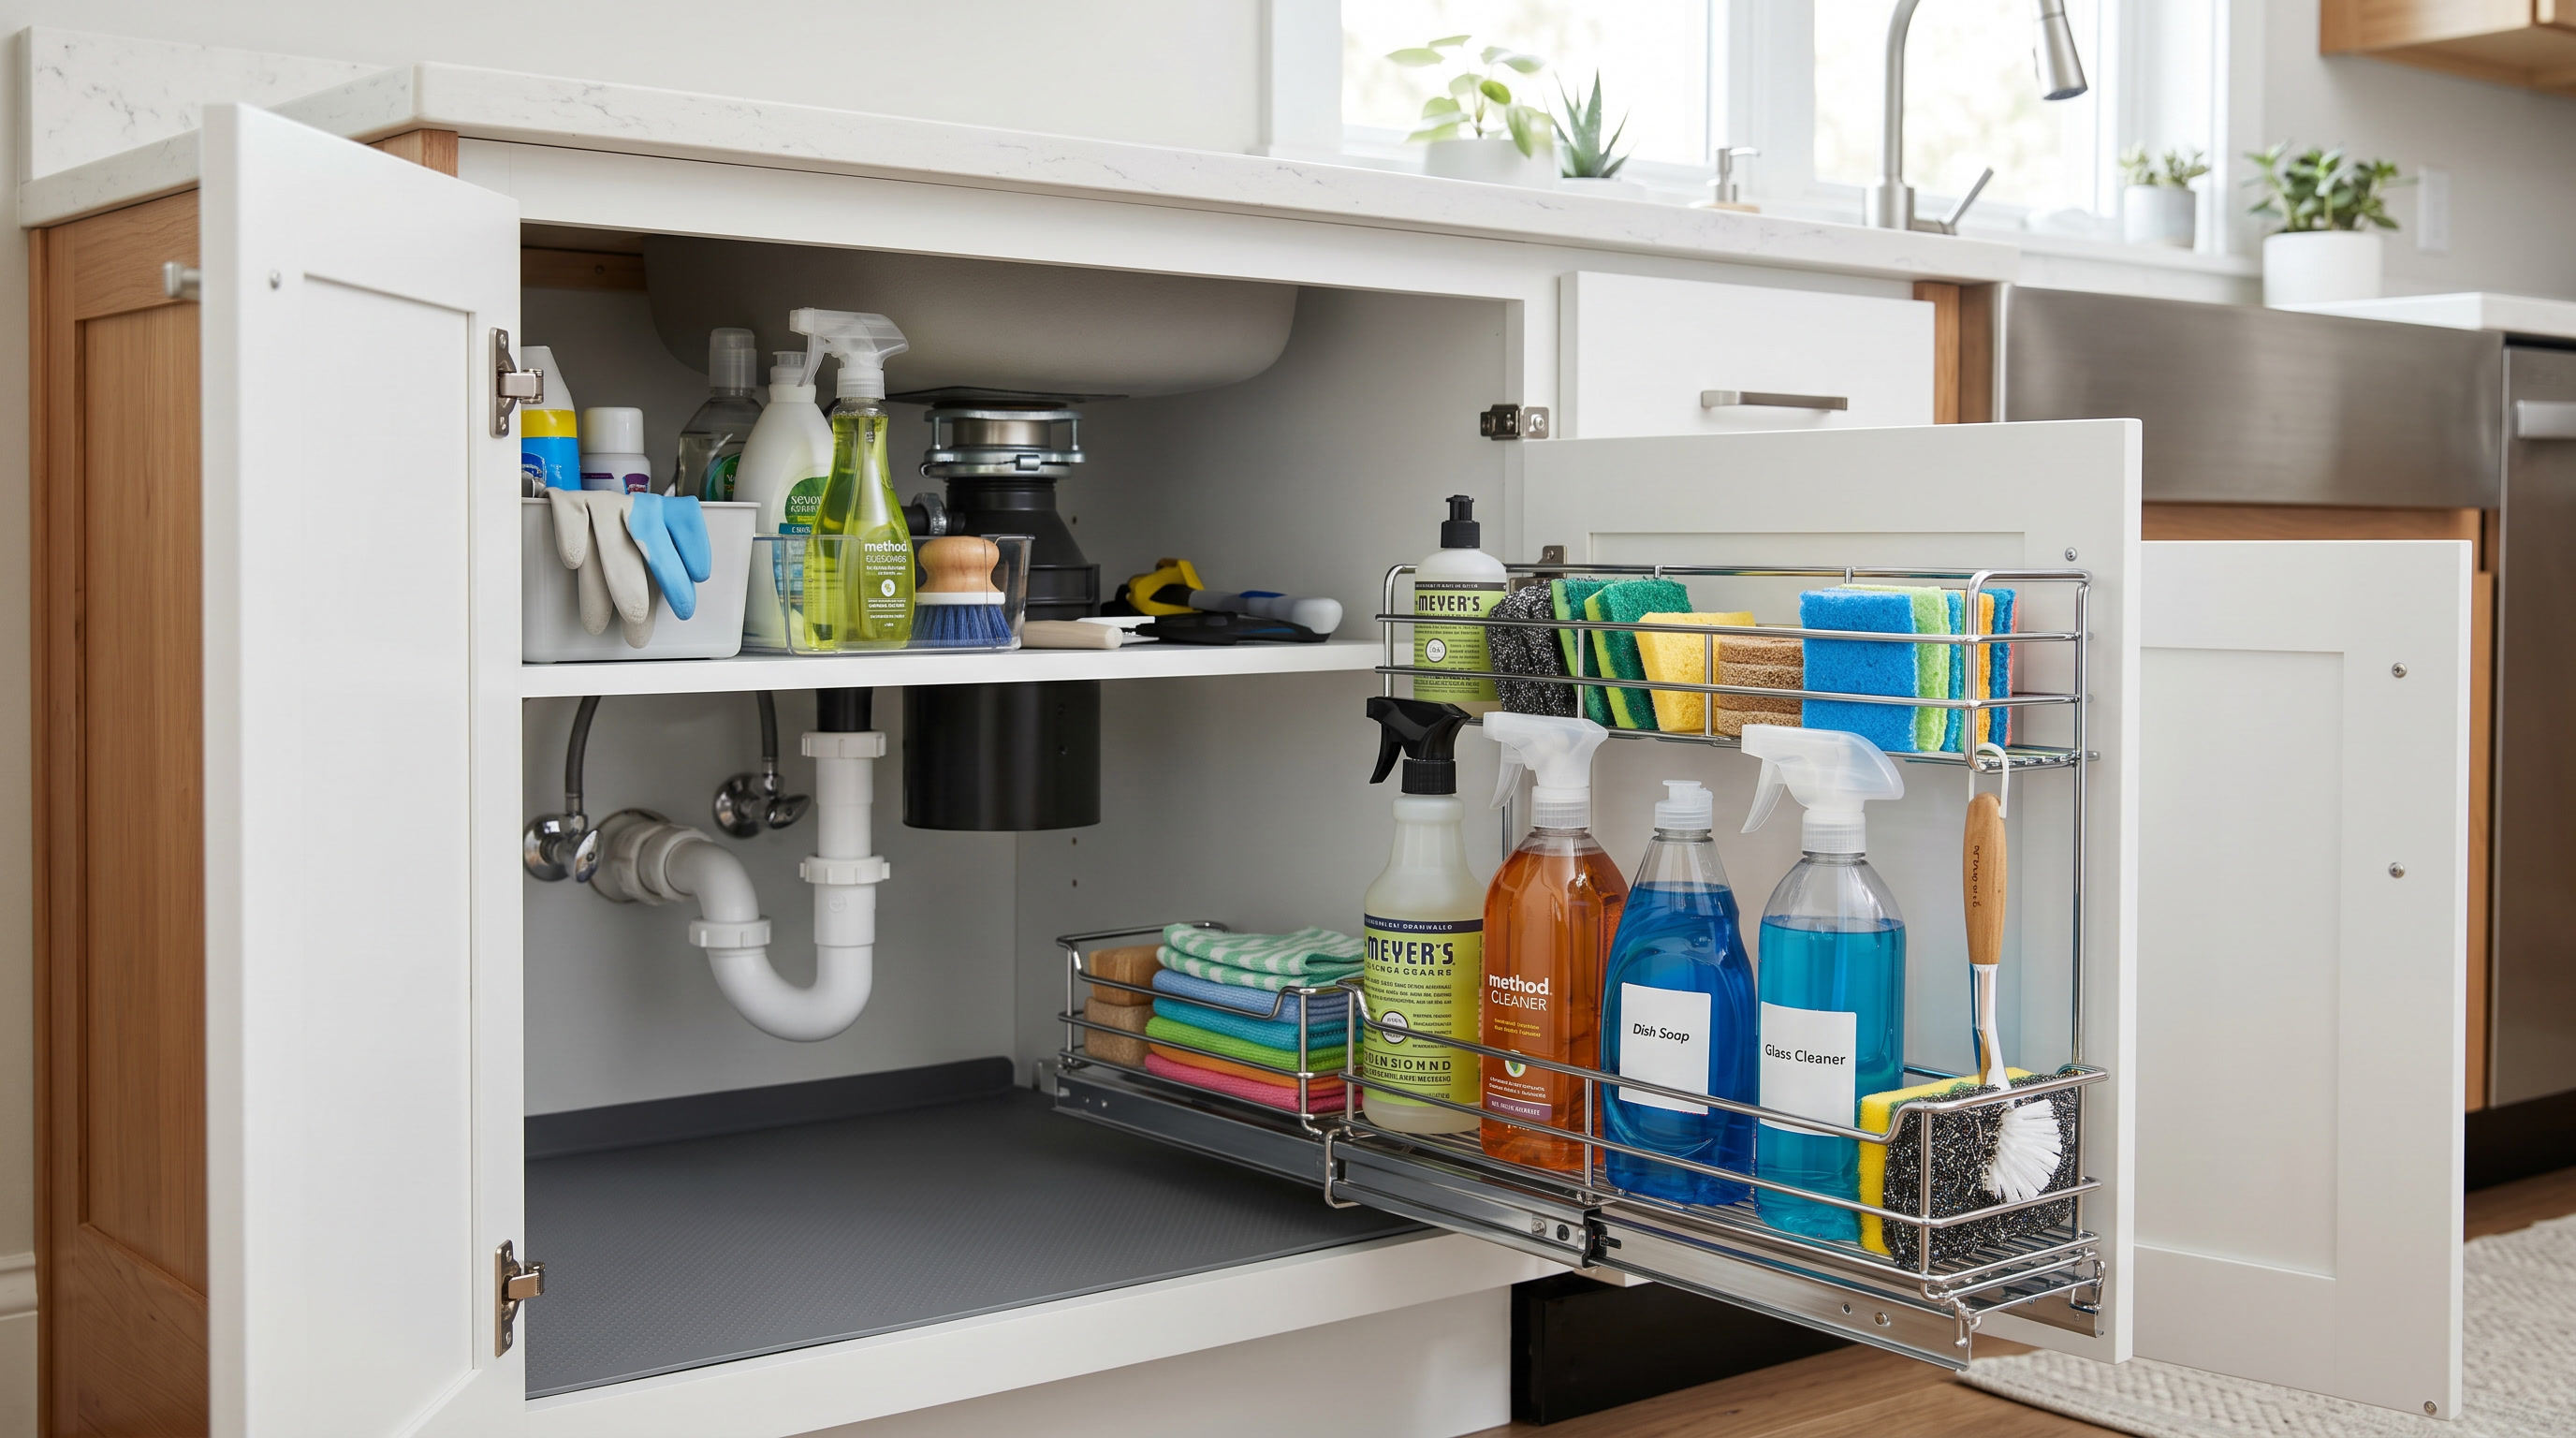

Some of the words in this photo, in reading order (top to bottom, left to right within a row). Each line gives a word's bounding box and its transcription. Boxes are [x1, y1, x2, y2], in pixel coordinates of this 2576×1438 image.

[864, 539, 907, 552] method
[1418, 594, 1480, 612] MEYER'S
[1368, 935, 1454, 966] MEYER'S
[1488, 974, 1549, 996] method
[1491, 990, 1547, 1011] CLEANER
[1632, 1022, 1657, 1038] Dish
[1658, 1027, 1690, 1045] Soap
[1764, 1043, 1793, 1061] Glass
[1794, 1049, 1847, 1065] Cleaner
